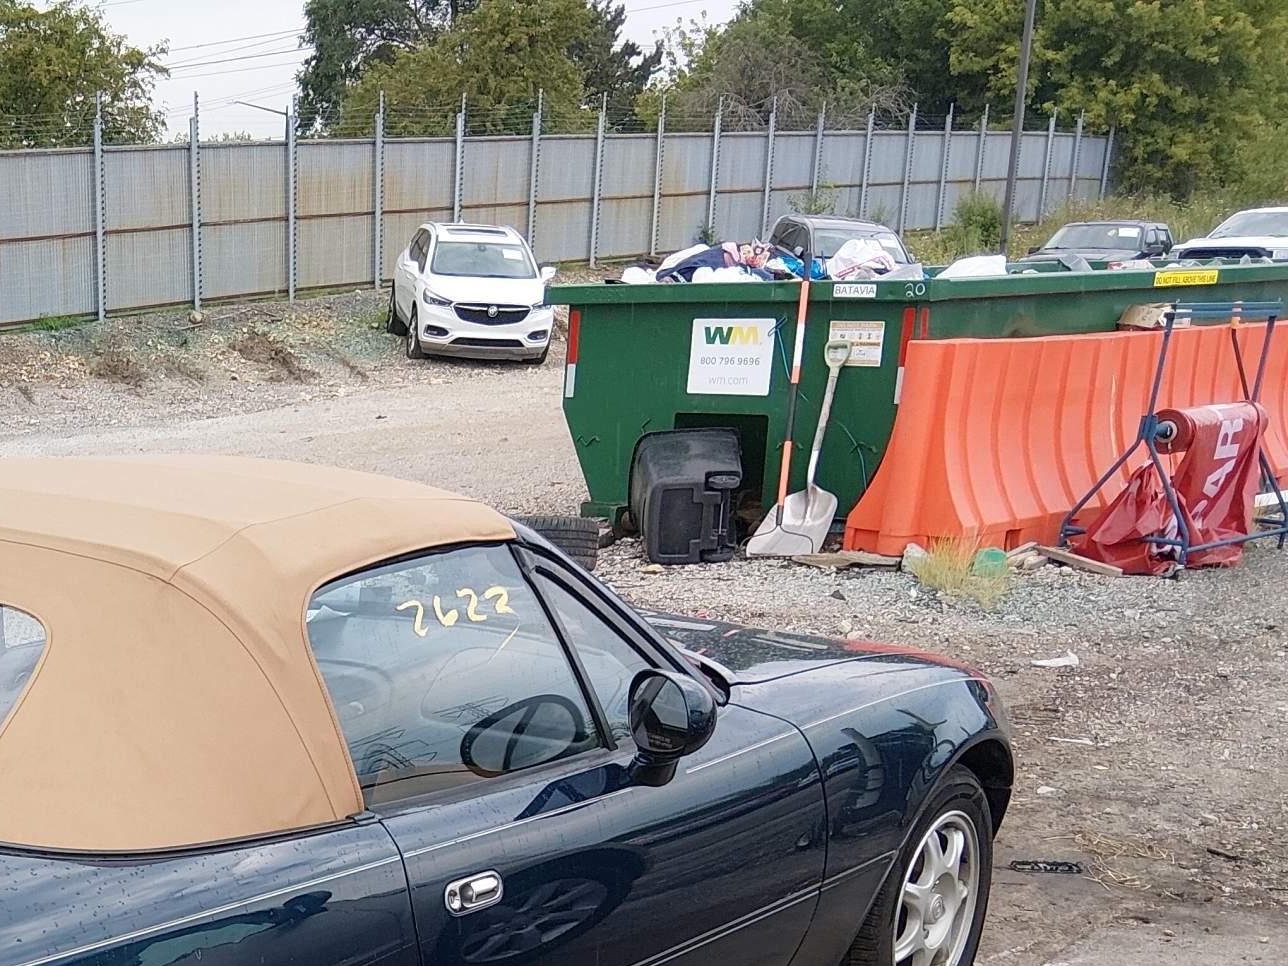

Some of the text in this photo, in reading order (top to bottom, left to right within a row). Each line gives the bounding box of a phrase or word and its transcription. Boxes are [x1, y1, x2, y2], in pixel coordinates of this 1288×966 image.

[834, 286, 875, 295] BATAVIA
[904, 283, 926, 298] 20
[704, 326, 759, 345] WM
[700, 356, 761, 366] 800 796 9696
[708, 377, 749, 385] wm.com
[396, 586, 518, 637] 2622
